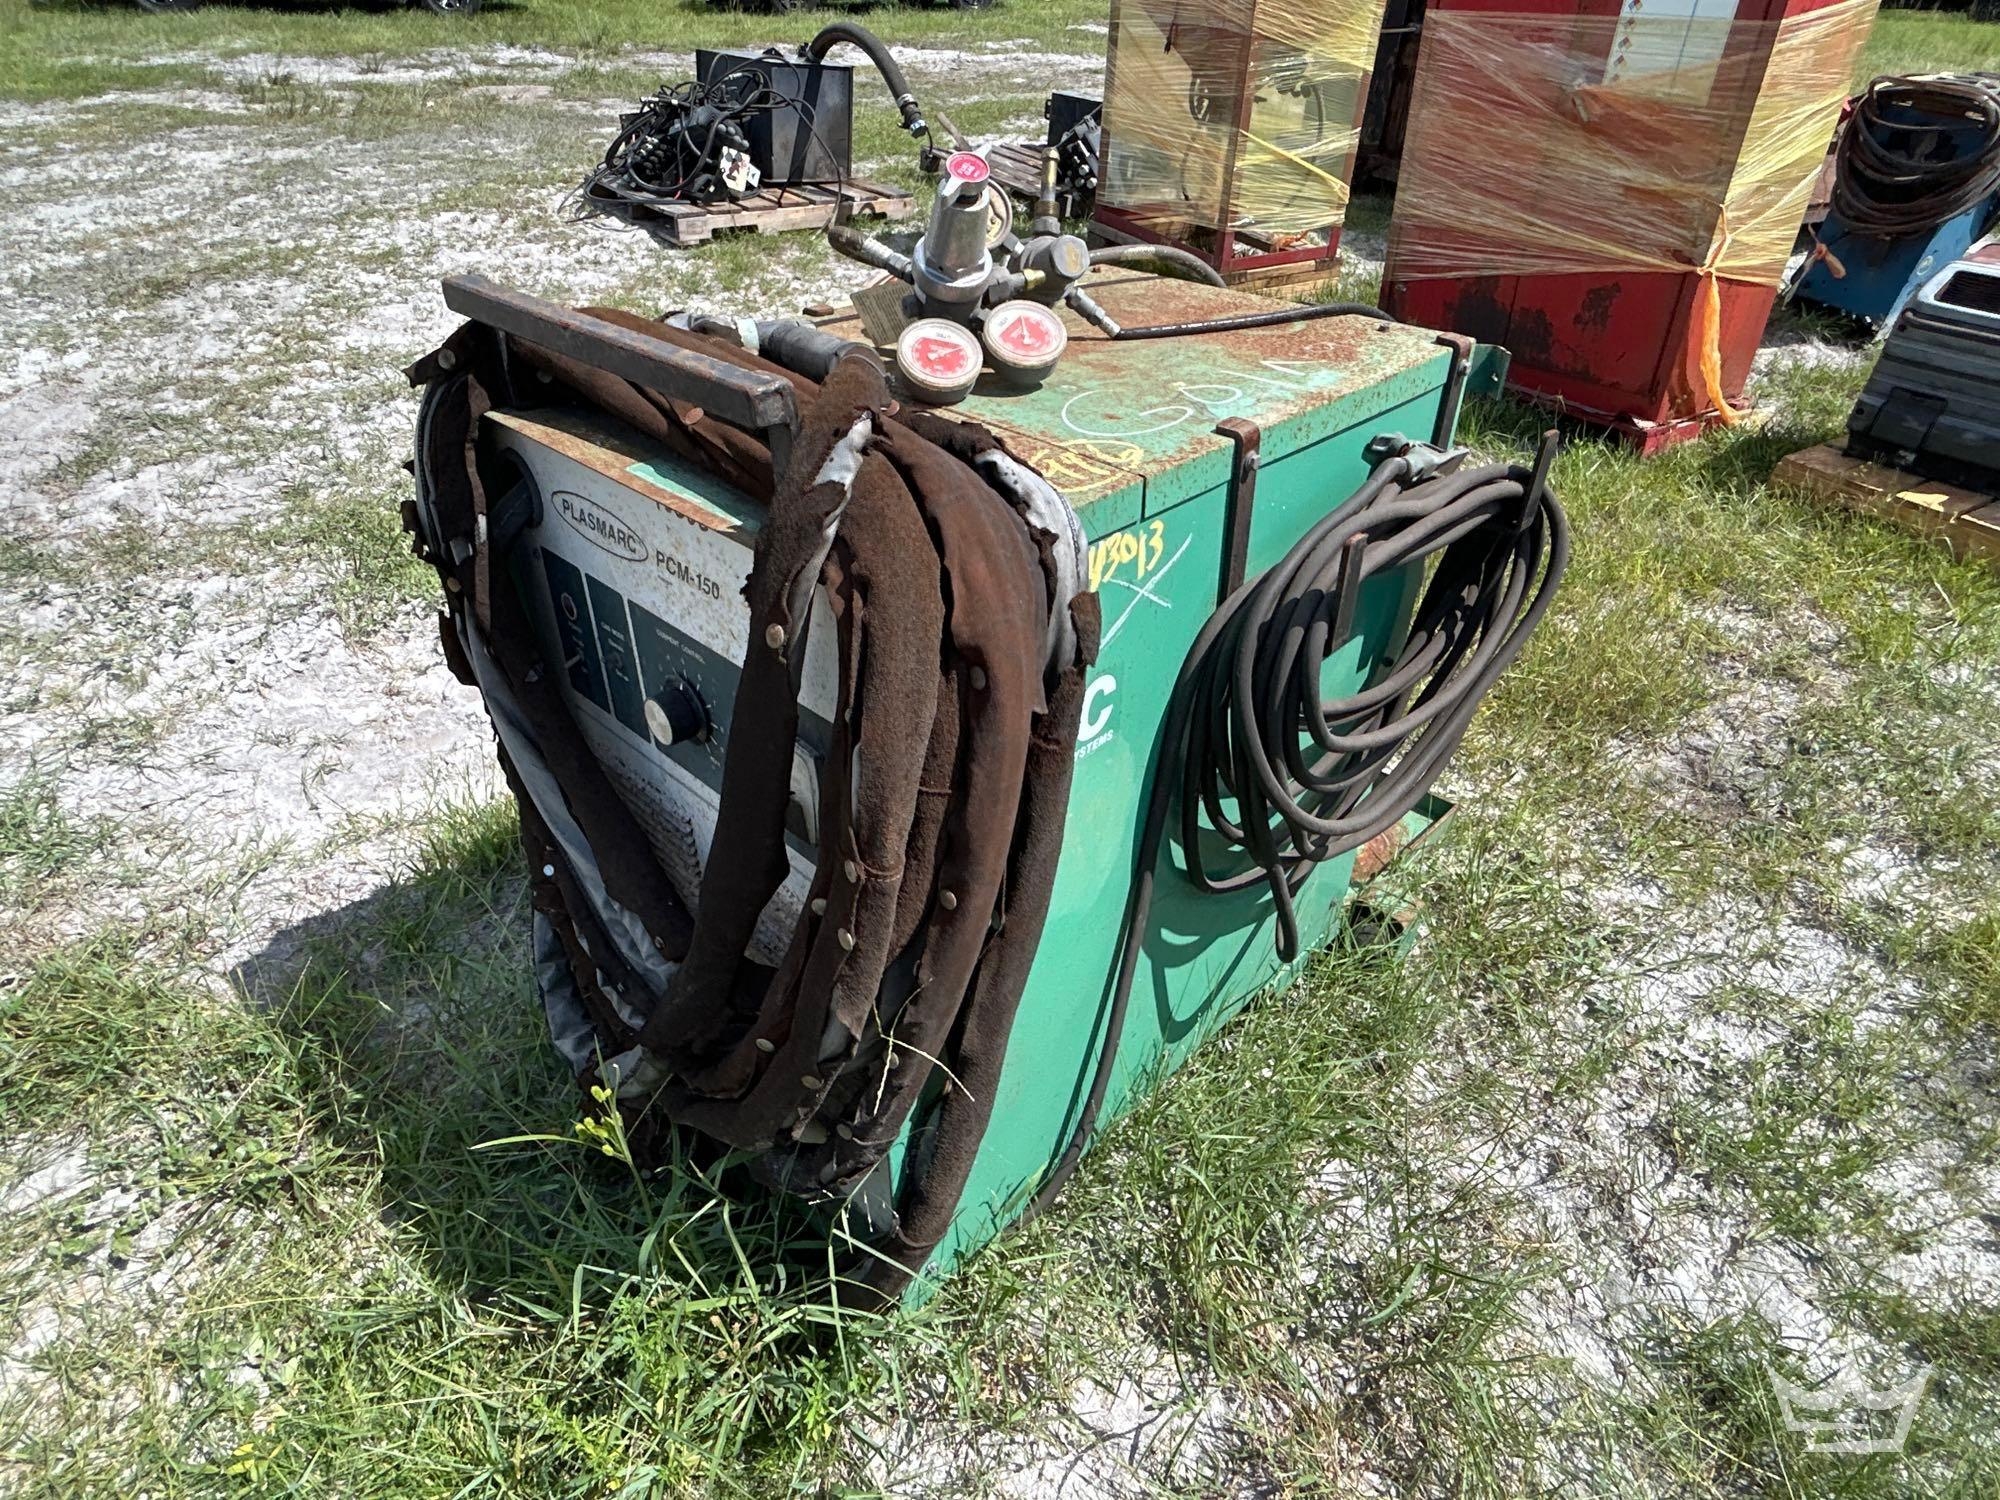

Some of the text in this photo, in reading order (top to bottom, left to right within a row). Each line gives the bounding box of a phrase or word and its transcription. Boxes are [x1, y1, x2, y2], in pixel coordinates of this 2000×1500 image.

[561, 498, 637, 554] PLASMARC
[656, 550, 721, 600] PCM-150
[1074, 729, 1115, 762] YSTEMS
